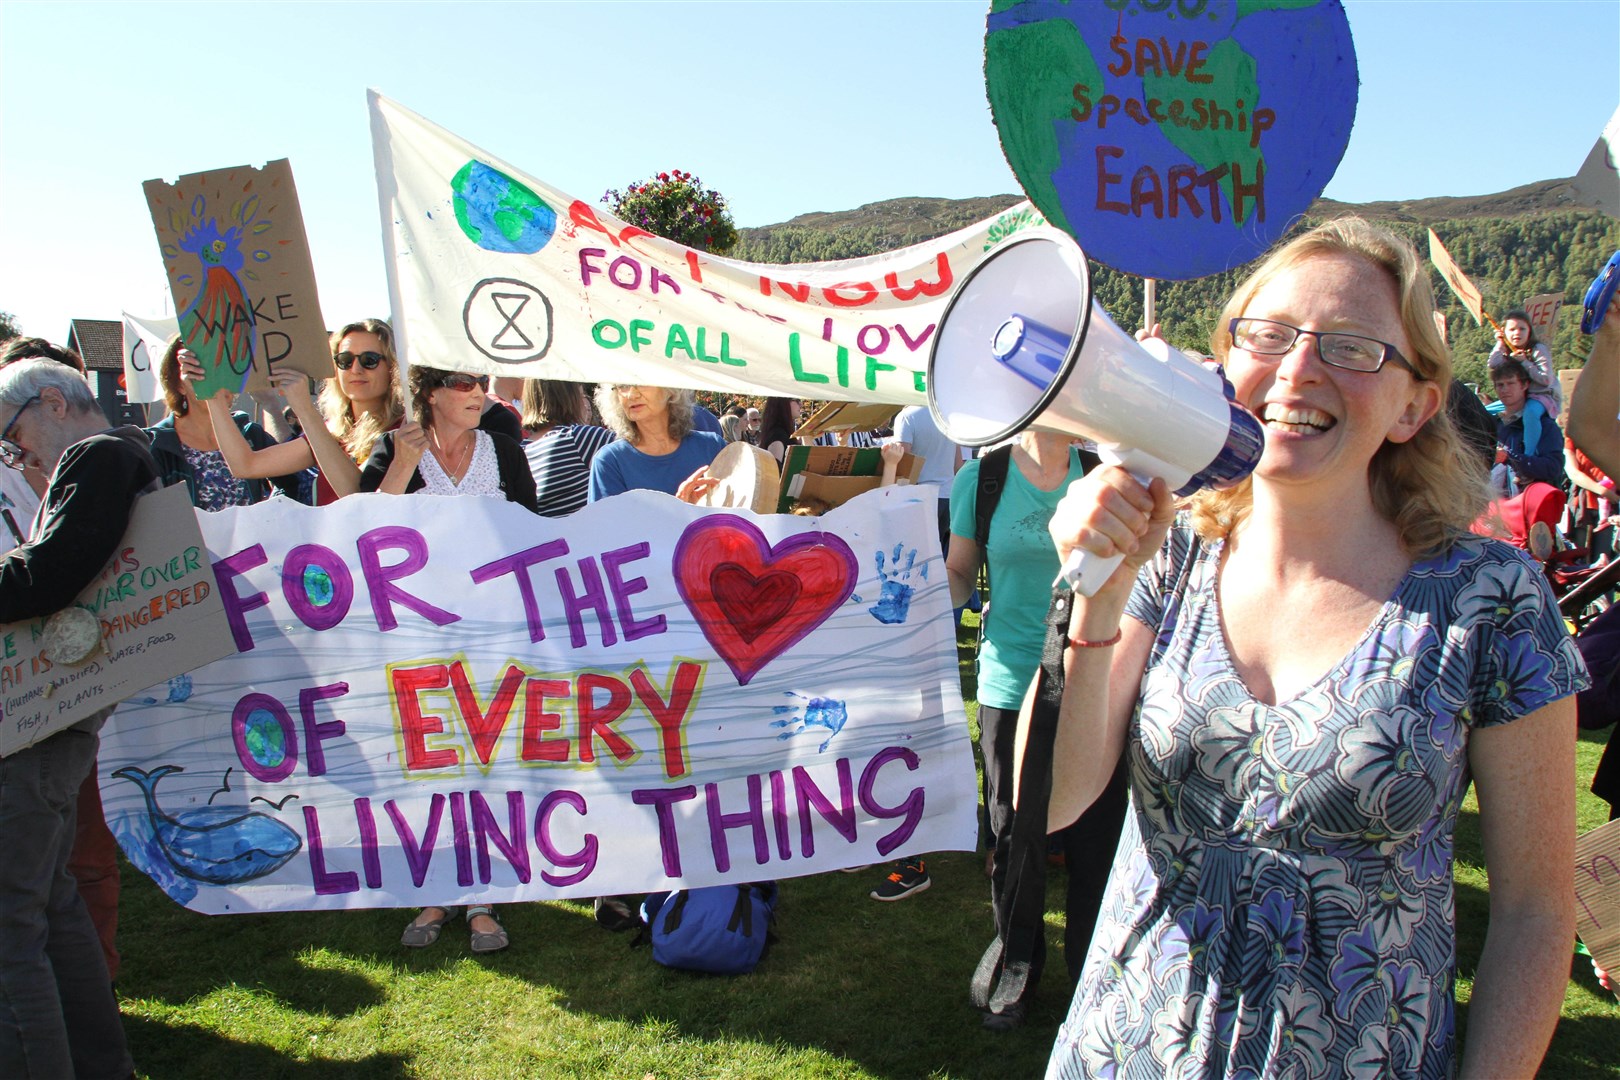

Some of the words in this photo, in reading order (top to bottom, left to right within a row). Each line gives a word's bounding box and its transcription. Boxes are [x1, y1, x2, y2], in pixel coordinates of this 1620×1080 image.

[1107, 36, 1214, 84] SAVE
[1071, 83, 1276, 148] Spaceship
[1095, 146, 1266, 224] EARTH
[193, 294, 298, 338] WAKE
[592, 319, 655, 353] OF
[665, 323, 747, 367] ALL
[224, 331, 292, 388] UP
[141, 546, 202, 590] OVER
[213, 525, 462, 652] FOR
[469, 537, 667, 649] THE
[107, 643, 146, 664] WATER,
[147, 632, 177, 648] FOOD,
[231, 681, 350, 783] OF
[388, 652, 706, 780] EVERY
[302, 789, 599, 896] LIVING
[631, 746, 925, 878] THING
